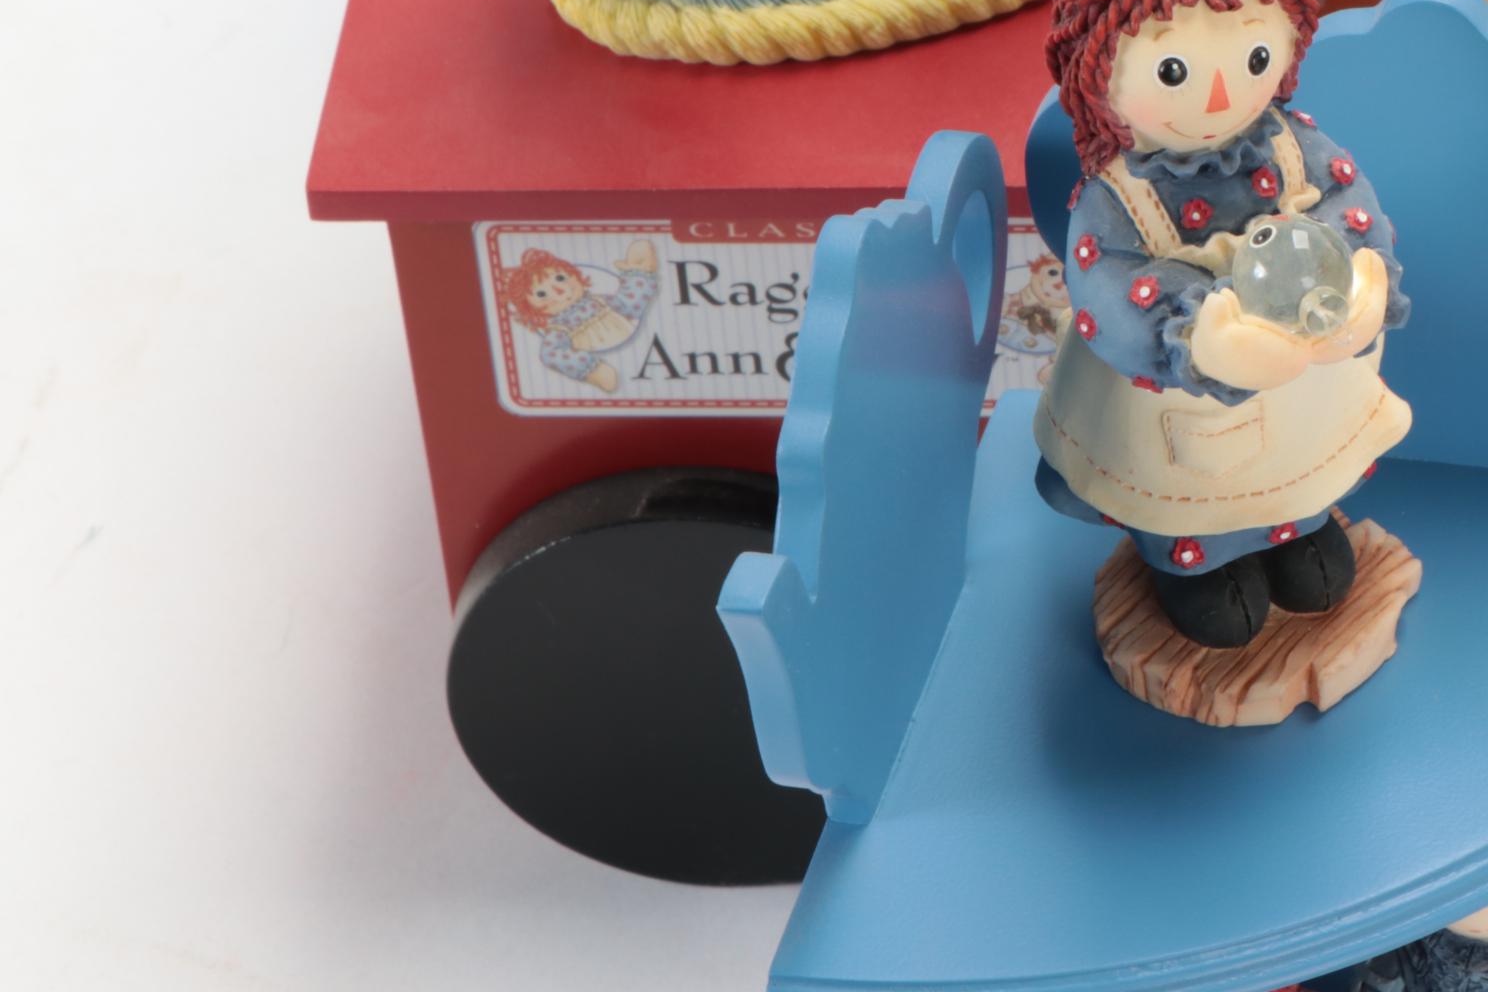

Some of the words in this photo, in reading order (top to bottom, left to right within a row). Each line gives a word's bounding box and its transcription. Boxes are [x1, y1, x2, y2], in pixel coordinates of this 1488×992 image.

[688, 221, 817, 239] CLAS
[667, 260, 810, 325] Rag
[631, 332, 769, 381] Ann
